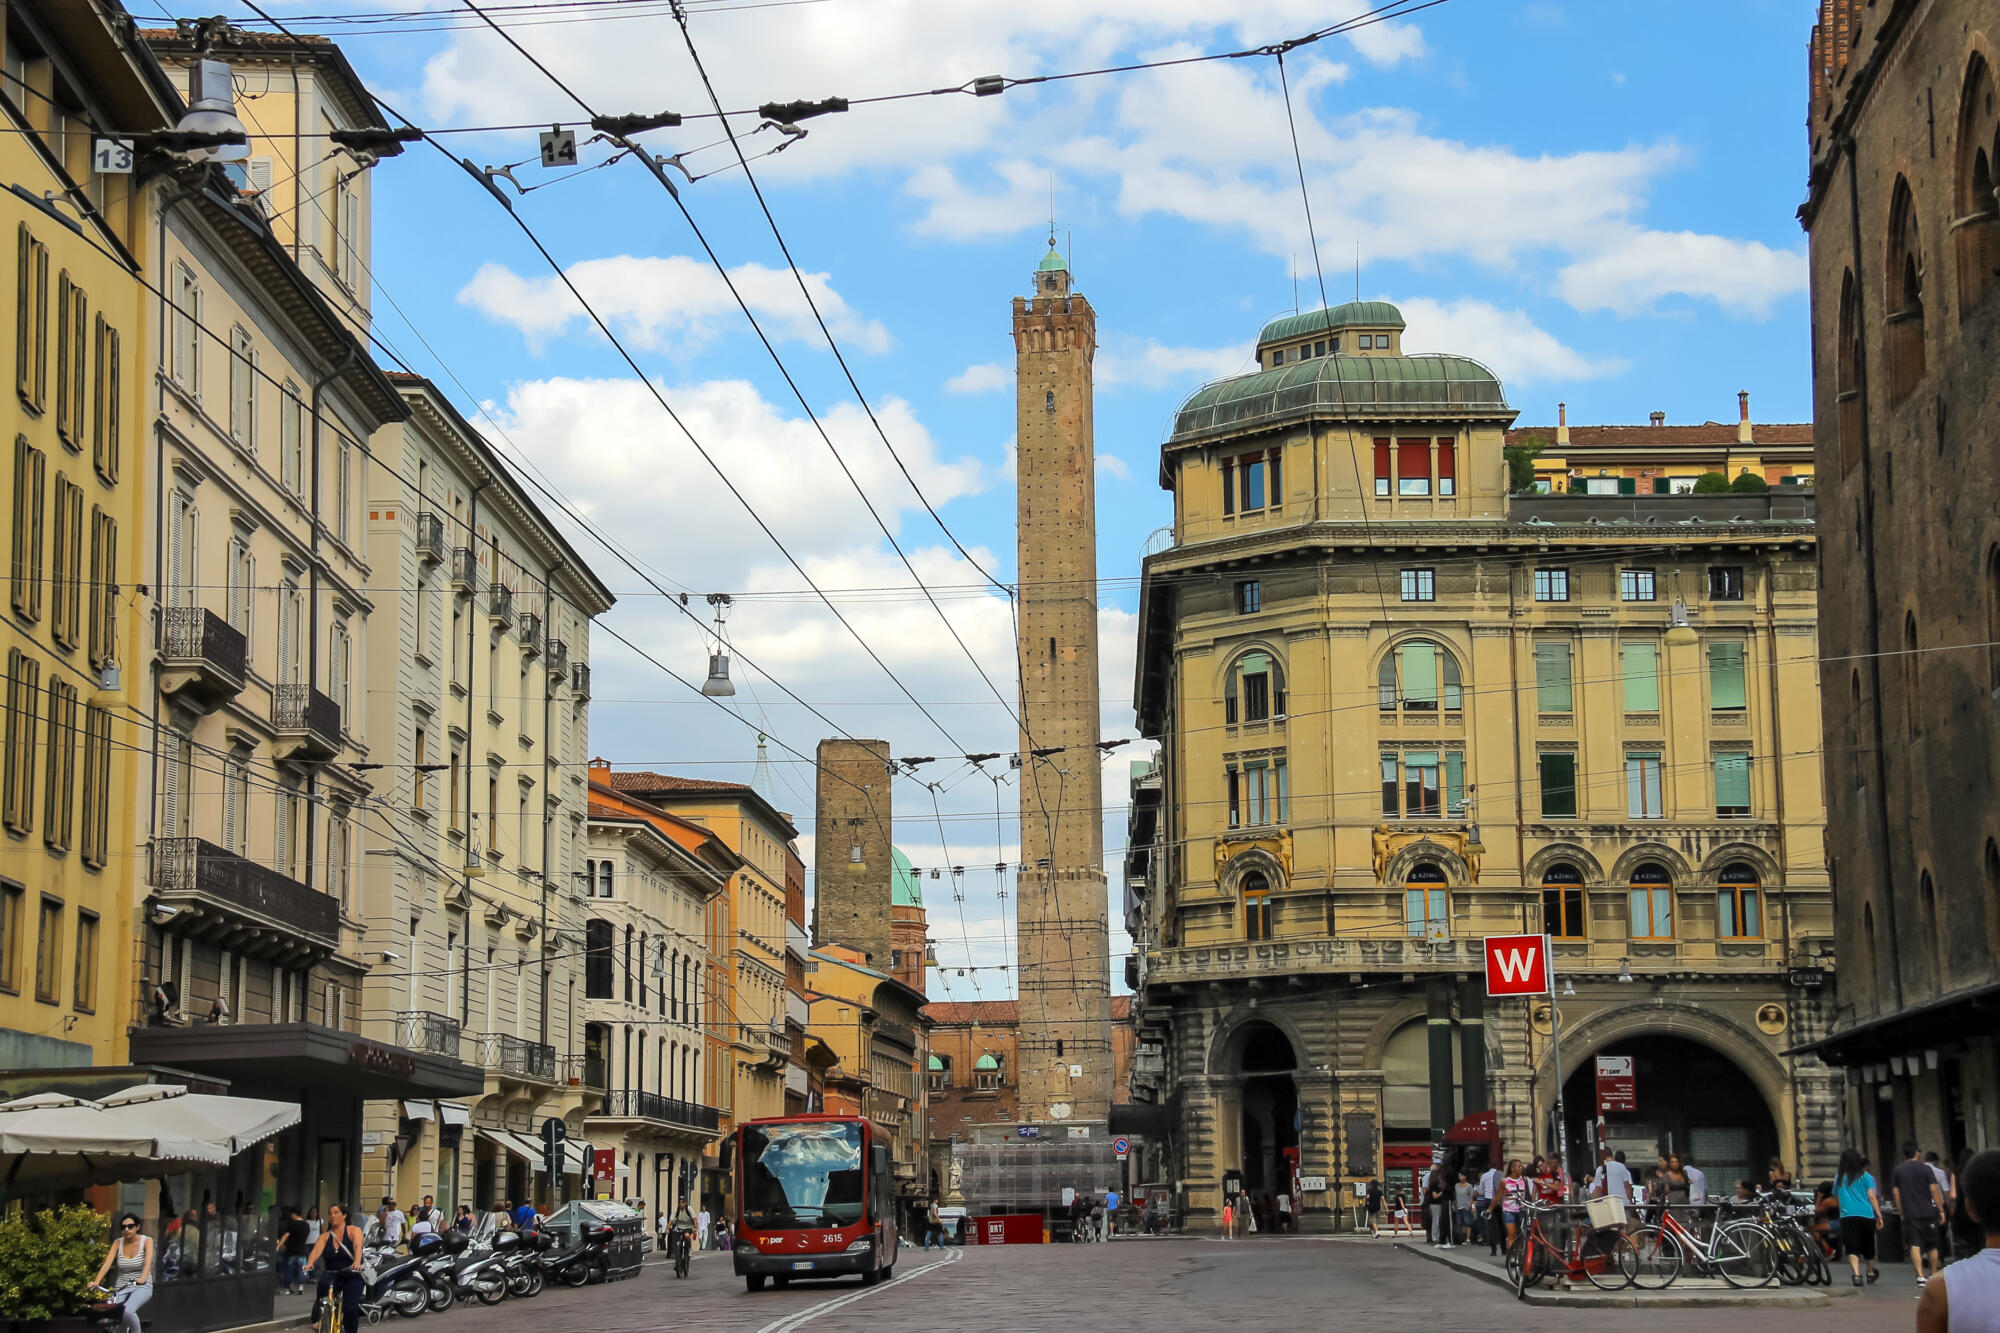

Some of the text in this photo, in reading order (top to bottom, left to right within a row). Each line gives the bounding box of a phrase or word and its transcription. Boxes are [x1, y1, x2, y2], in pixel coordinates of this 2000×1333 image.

[97, 149, 131, 169] 13
[541, 140, 575, 162] 14
[1493, 947, 1536, 983] W
[823, 1233, 843, 1243] 2615
